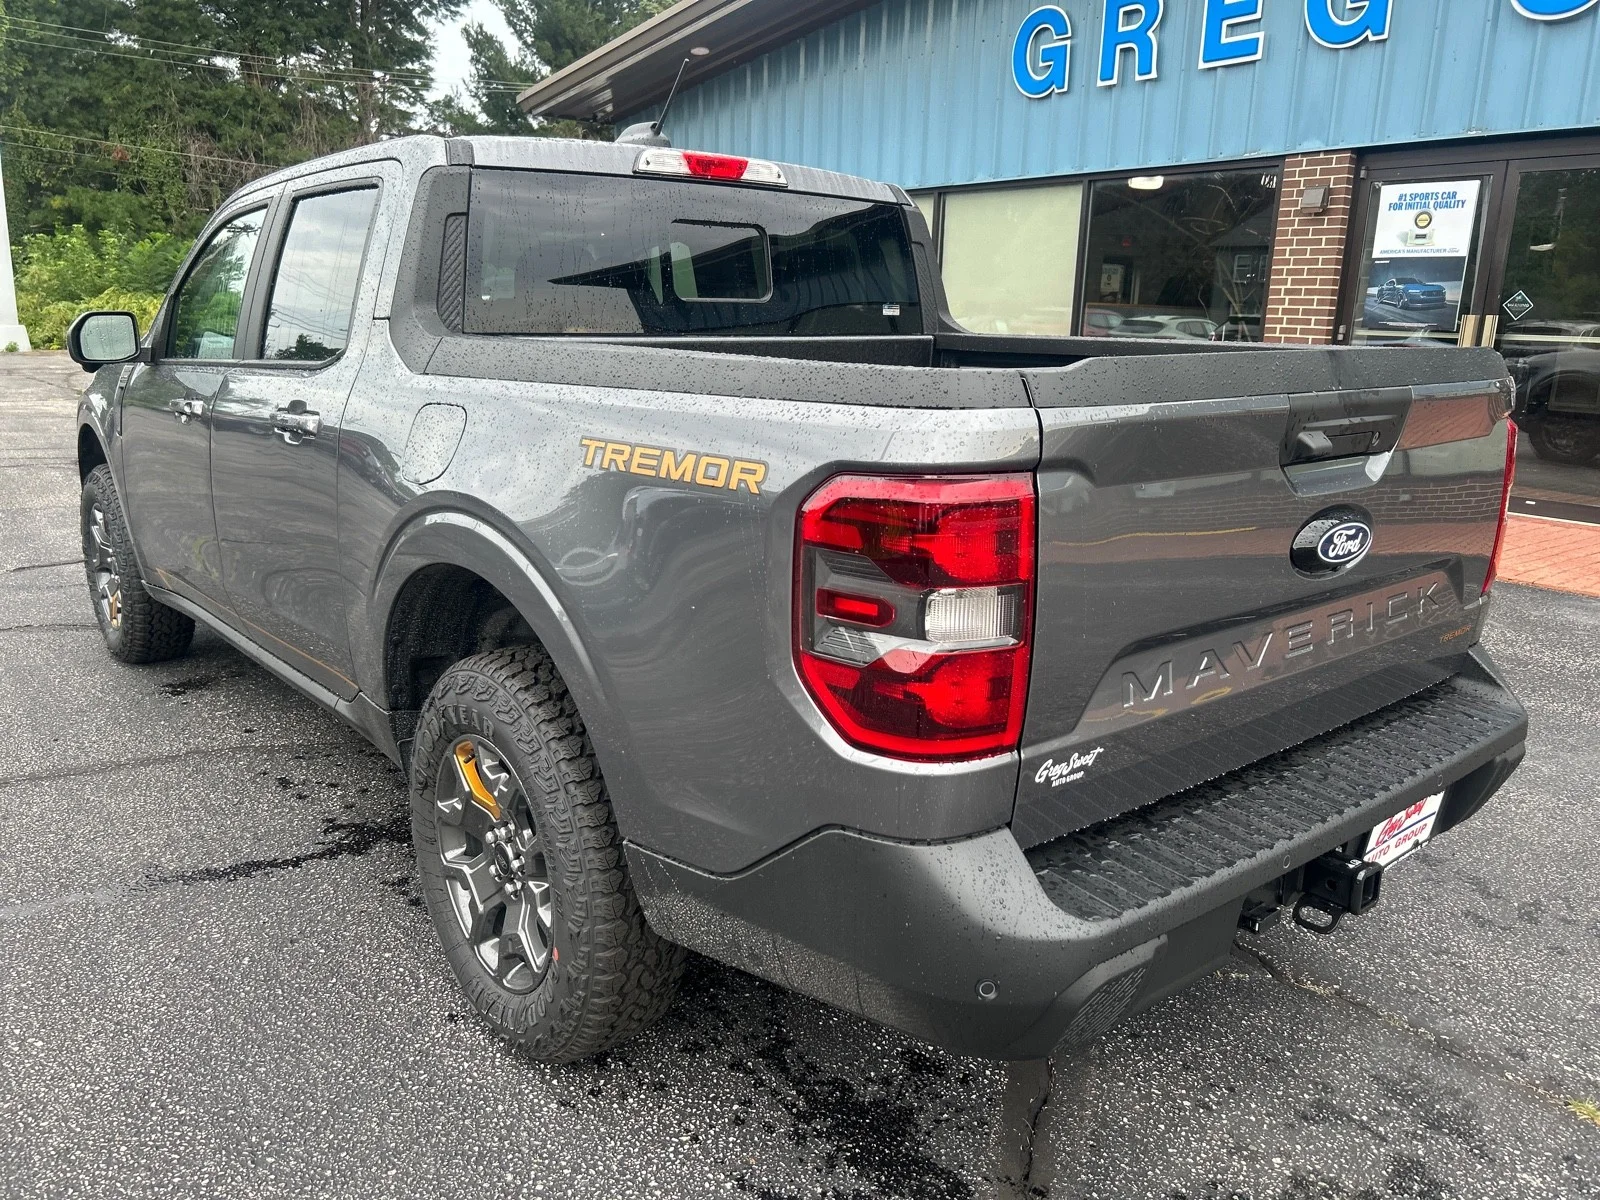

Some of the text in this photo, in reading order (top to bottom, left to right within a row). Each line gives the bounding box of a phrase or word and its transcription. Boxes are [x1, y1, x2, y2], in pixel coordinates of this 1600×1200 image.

[1388, 200, 1466, 211] FOR INITIAL QUALITY
[1398, 191, 1458, 202] #1 SPORTS CAR
[580, 436, 769, 495] TREMOR
[1328, 528, 1363, 557] Ford
[1122, 582, 1440, 708] MAVERICK
[1440, 624, 1472, 643] TREMOR
[1035, 746, 1105, 783] Greg Sweet
[1052, 770, 1085, 788] AUTO GROUP
[1395, 823, 1428, 849] GROUP
